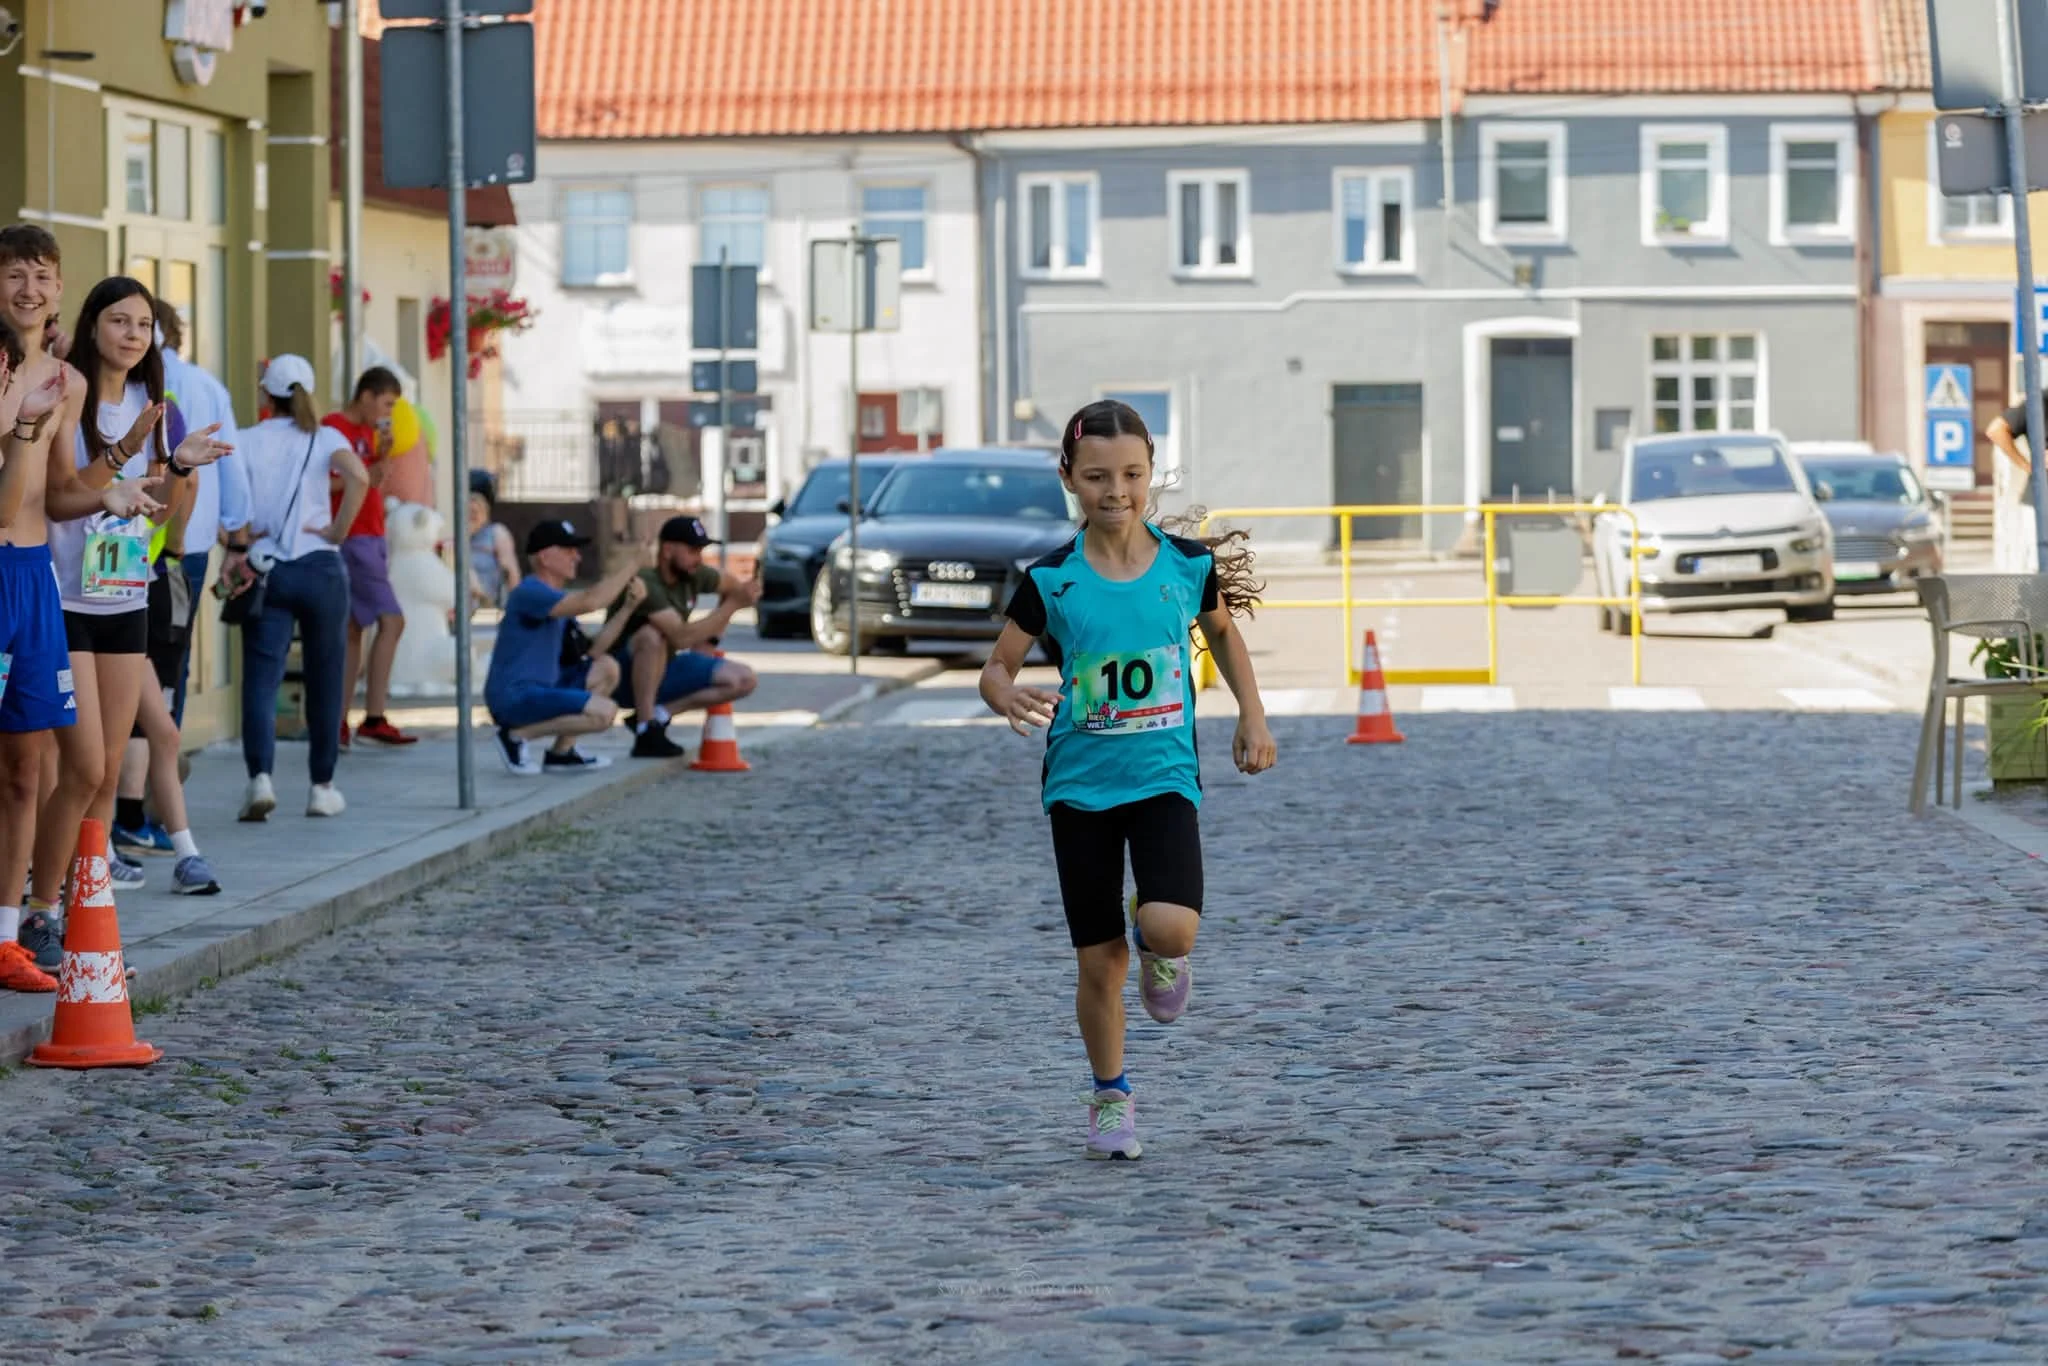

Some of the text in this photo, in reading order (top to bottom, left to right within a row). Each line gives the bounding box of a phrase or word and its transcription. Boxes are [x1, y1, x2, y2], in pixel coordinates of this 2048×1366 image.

[1933, 420, 1965, 462] P
[96, 541, 119, 573] 11
[1101, 659, 1153, 701] 10
